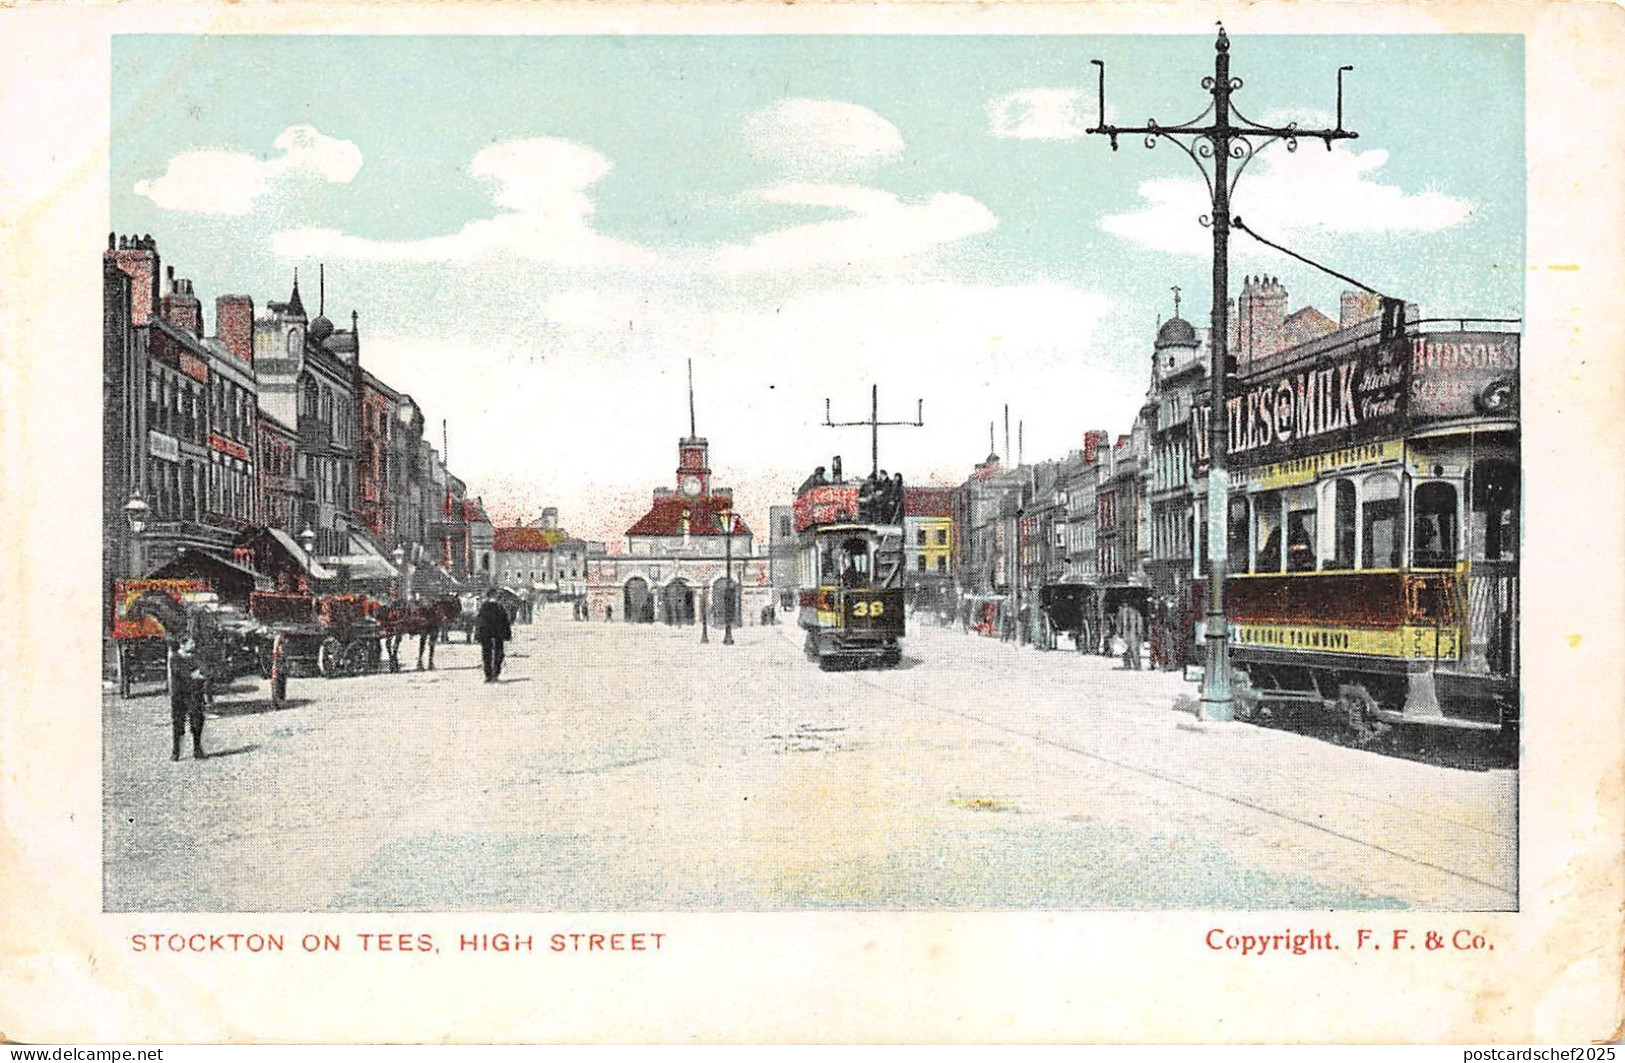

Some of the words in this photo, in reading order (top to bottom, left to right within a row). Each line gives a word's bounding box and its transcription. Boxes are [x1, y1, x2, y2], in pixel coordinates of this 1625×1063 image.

[1192, 386, 1273, 460] NTLE'S
[1296, 361, 1358, 440] MILK
[131, 933, 284, 951] STOCKTON
[301, 933, 341, 951] ON
[357, 933, 441, 955] TEES,
[460, 933, 533, 951] HIGH
[550, 933, 666, 951] STREET
[1205, 928, 1340, 956] Copyright.
[1356, 929, 1380, 950] F.
[1392, 929, 1415, 950] F.
[1425, 930, 1444, 951] &
[1452, 929, 1495, 951] Co.
